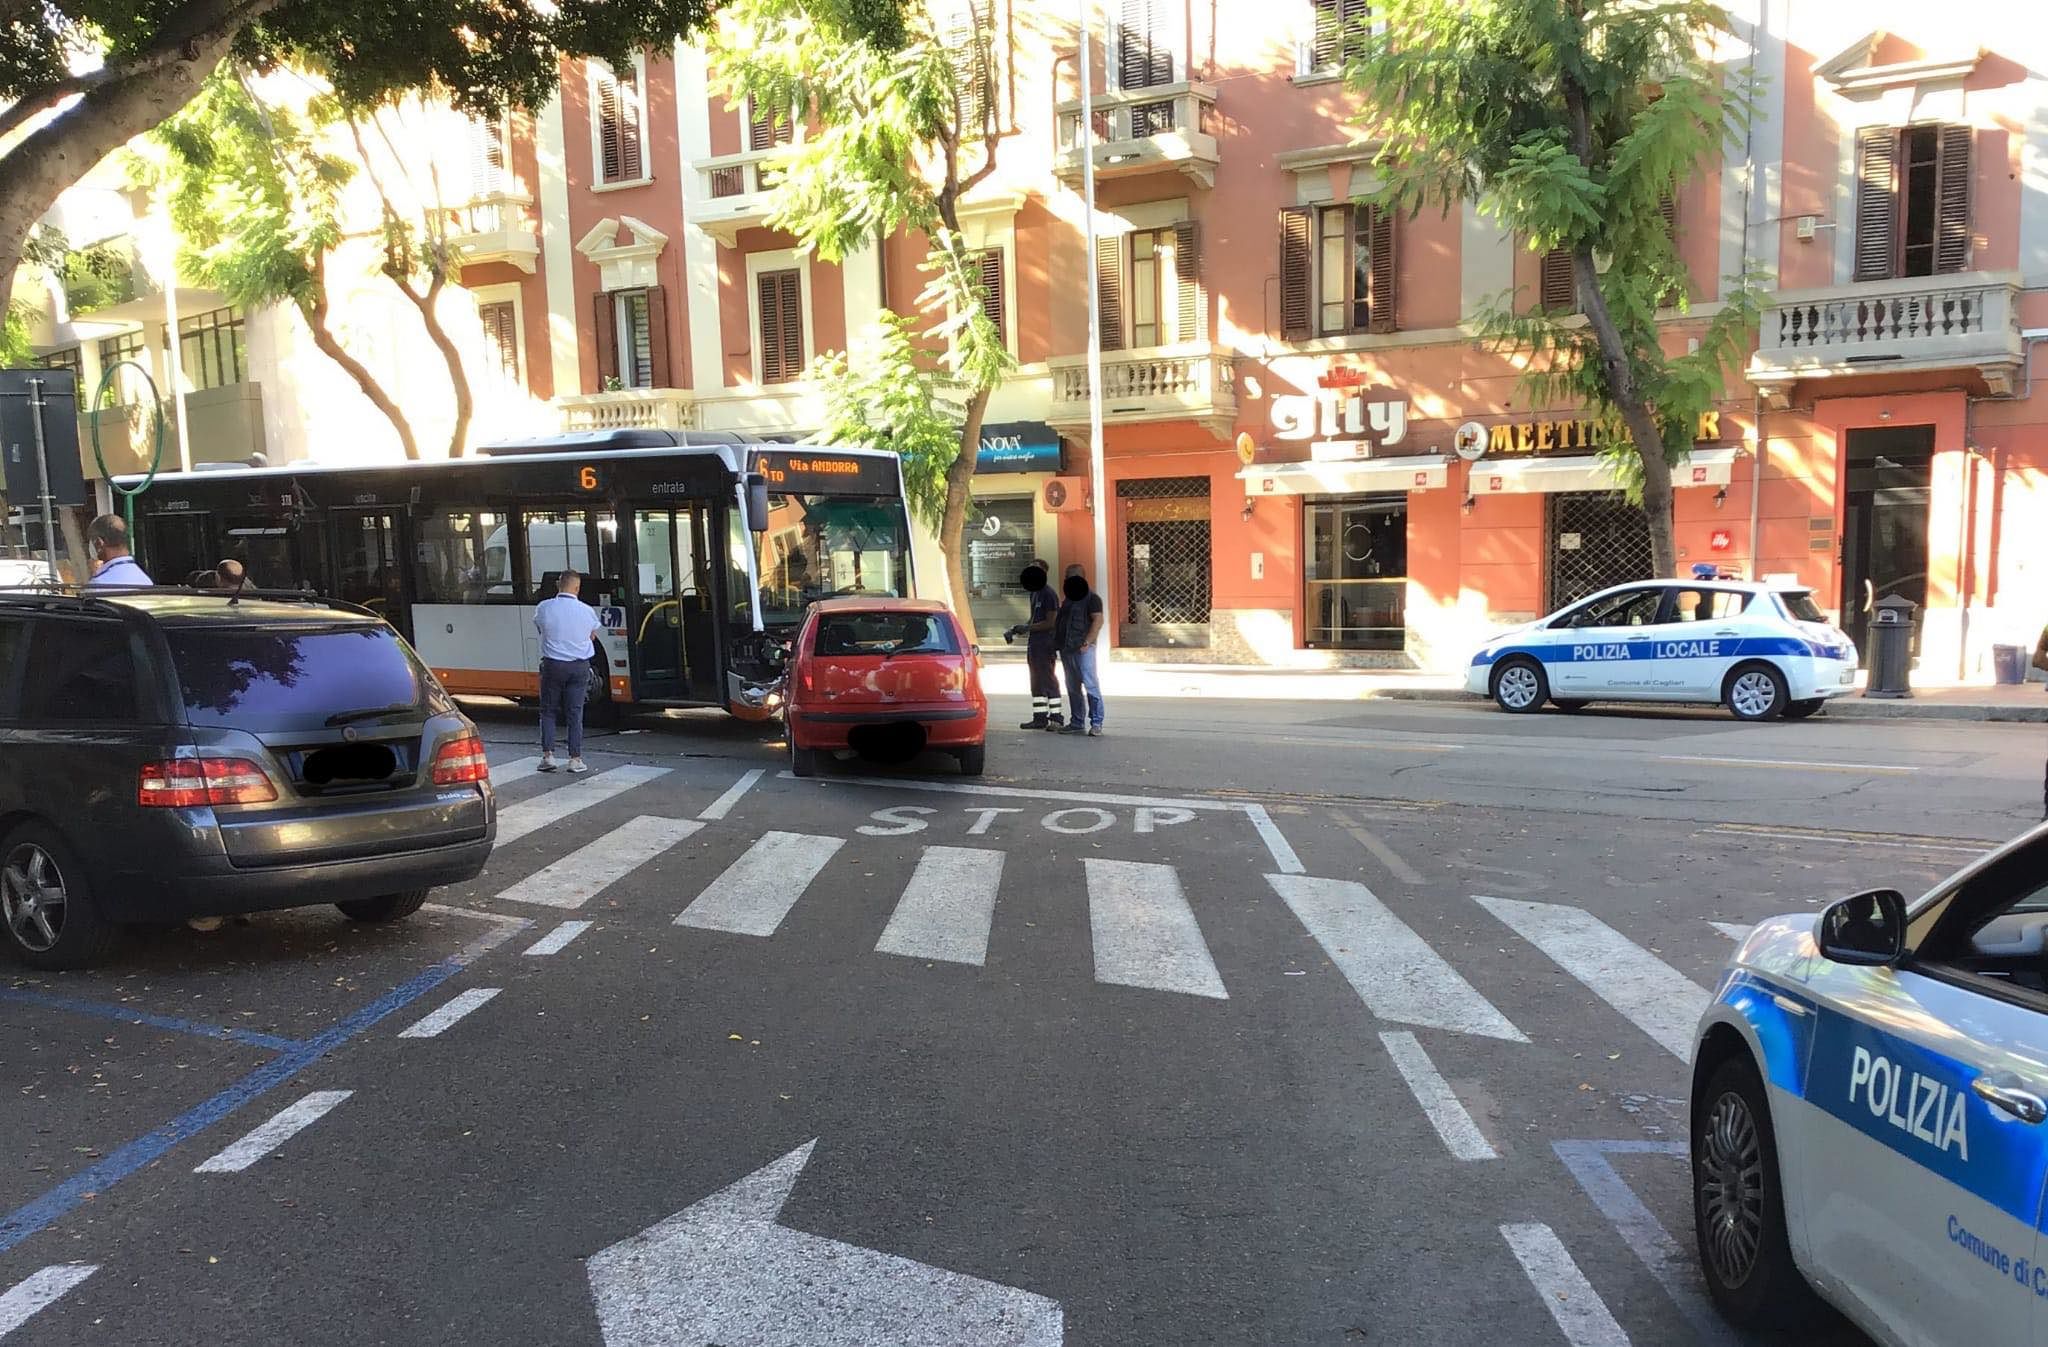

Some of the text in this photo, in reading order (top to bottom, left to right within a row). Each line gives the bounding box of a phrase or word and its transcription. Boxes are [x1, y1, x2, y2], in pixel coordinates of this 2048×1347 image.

[789, 459, 859, 474] Via ANDORRA
[581, 467, 597, 489] 6
[652, 481, 686, 494] entrata
[1573, 641, 1720, 661] POLIZIA LOCALE
[854, 805, 1199, 837] STOP
[1850, 1045, 1969, 1162] POLIZIA
[1948, 1214, 2010, 1274] Comune
[2014, 1257, 2030, 1287] di
